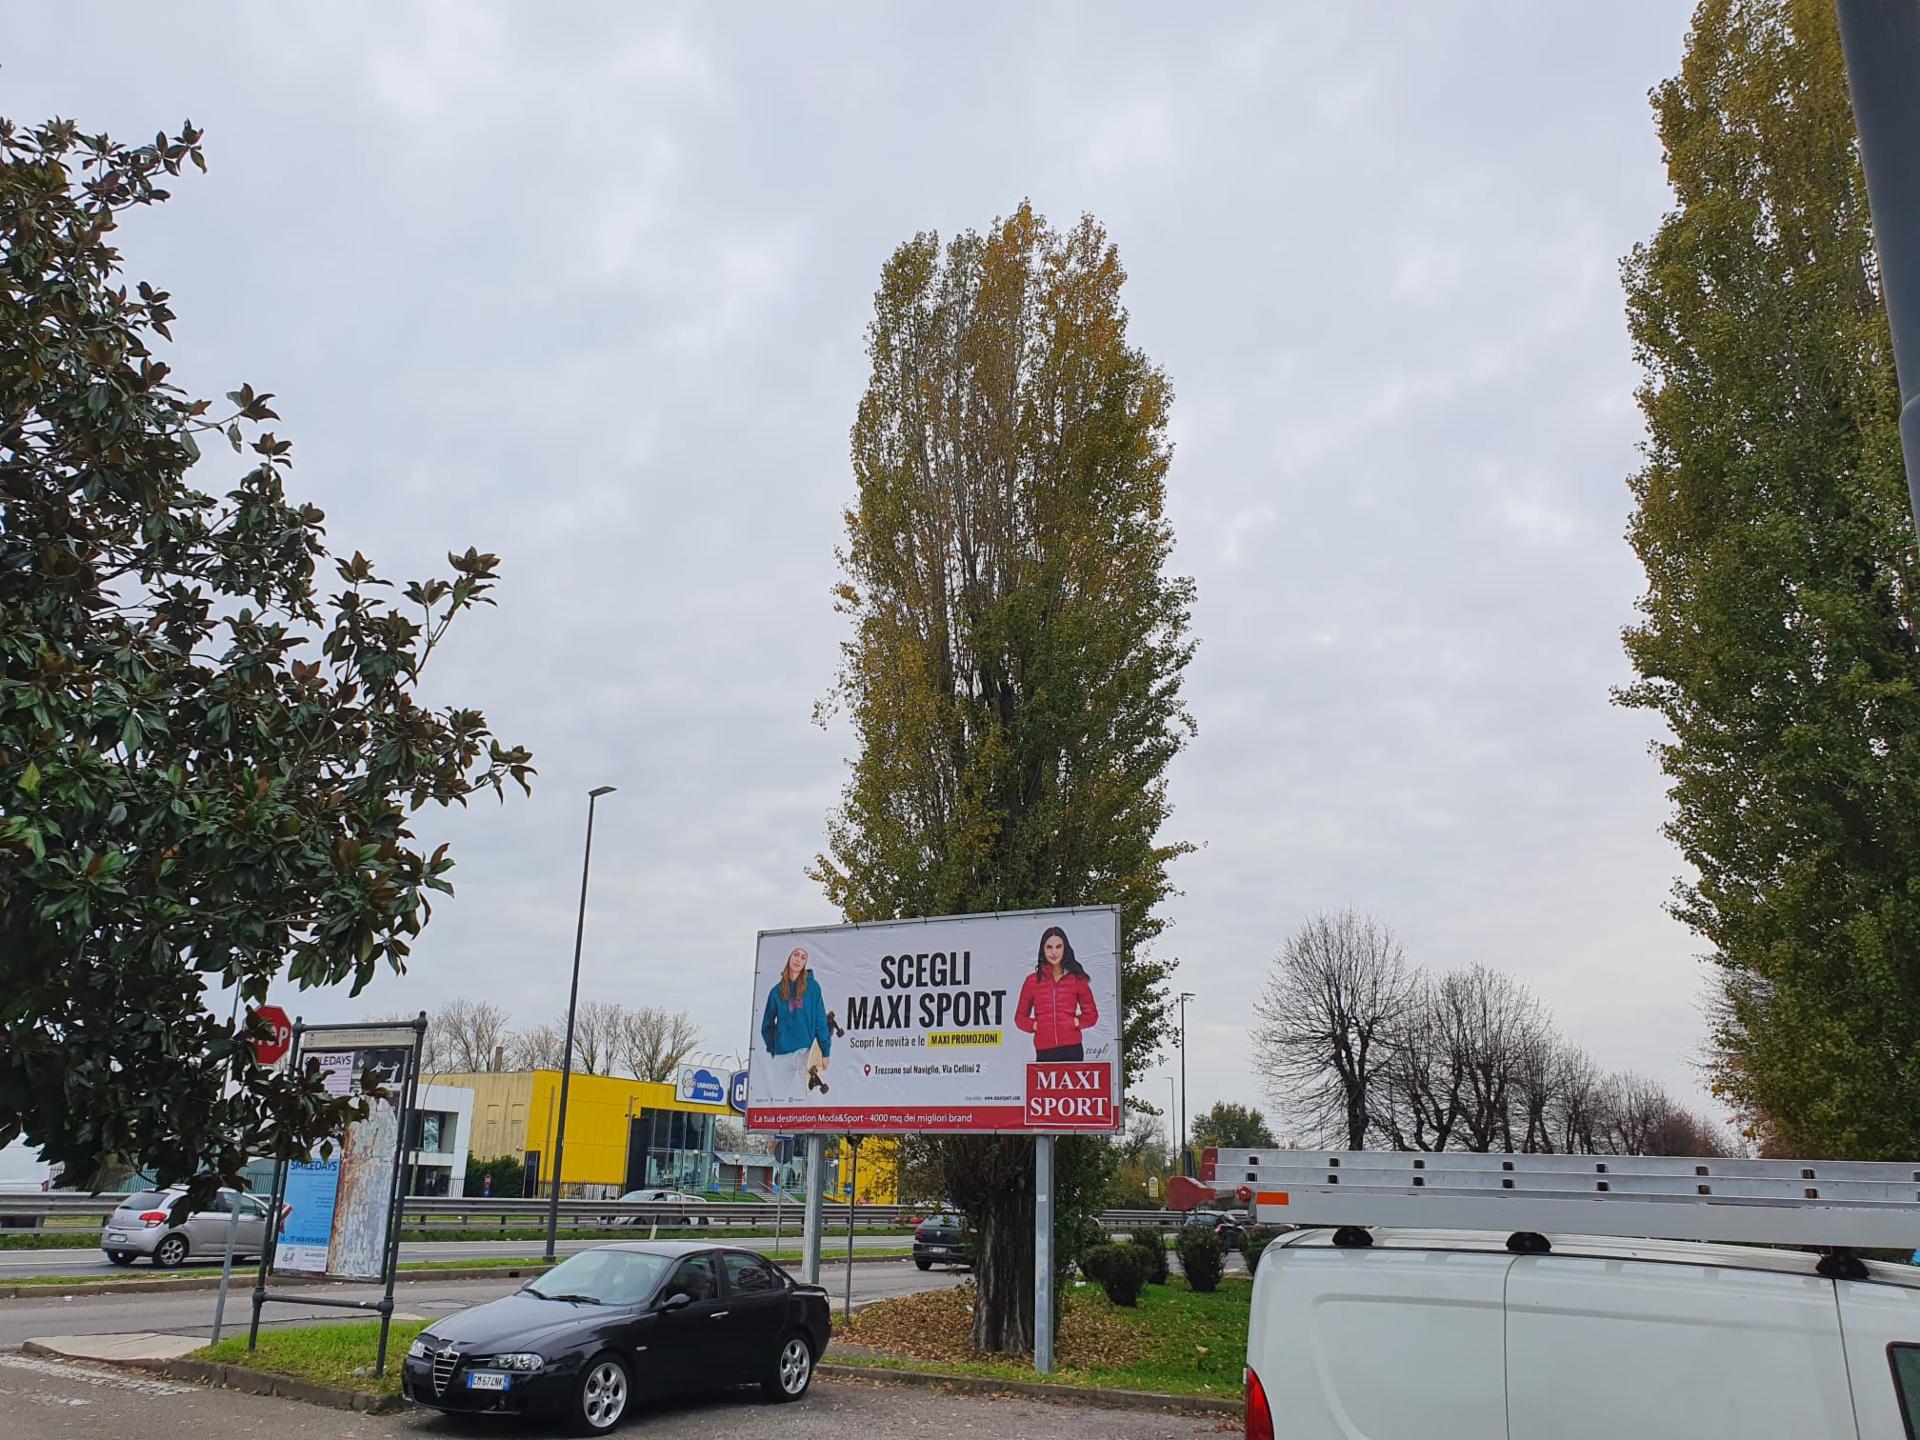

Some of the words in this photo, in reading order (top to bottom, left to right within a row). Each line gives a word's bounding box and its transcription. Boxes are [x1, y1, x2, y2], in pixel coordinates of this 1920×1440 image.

[880, 951, 970, 989] SCEGLI
[847, 994, 911, 1030] MAXI
[919, 990, 1007, 1028] SPORT
[850, 1037, 875, 1049] Scopri
[876, 1037, 884, 1047] le
[885, 1035, 910, 1047] novità
[911, 1038, 916, 1047] e
[917, 1035, 926, 1046] le
[931, 1034, 950, 1045] MAXI
[951, 1033, 998, 1044] PROMOZIONI
[874, 1065, 902, 1075] Trezzano
[902, 1065, 912, 1074] sul
[914, 1064, 941, 1075] Naviglio,
[942, 1064, 952, 1073] Via
[954, 1063, 975, 1073] Cellini
[975, 1063, 981, 1073] 2
[1036, 1070, 1101, 1090] MAXI
[1030, 1097, 1108, 1117] SPORT
[754, 1114, 763, 1123] La
[763, 1115, 775, 1123] tua
[776, 1114, 816, 1123] destination
[817, 1113, 864, 1124] Moda&Sport
[869, 1113, 889, 1123] 4000
[889, 1114, 902, 1124] mq
[903, 1113, 916, 1123] dei
[917, 1113, 948, 1124] migliori
[948, 1112, 973, 1123] brand
